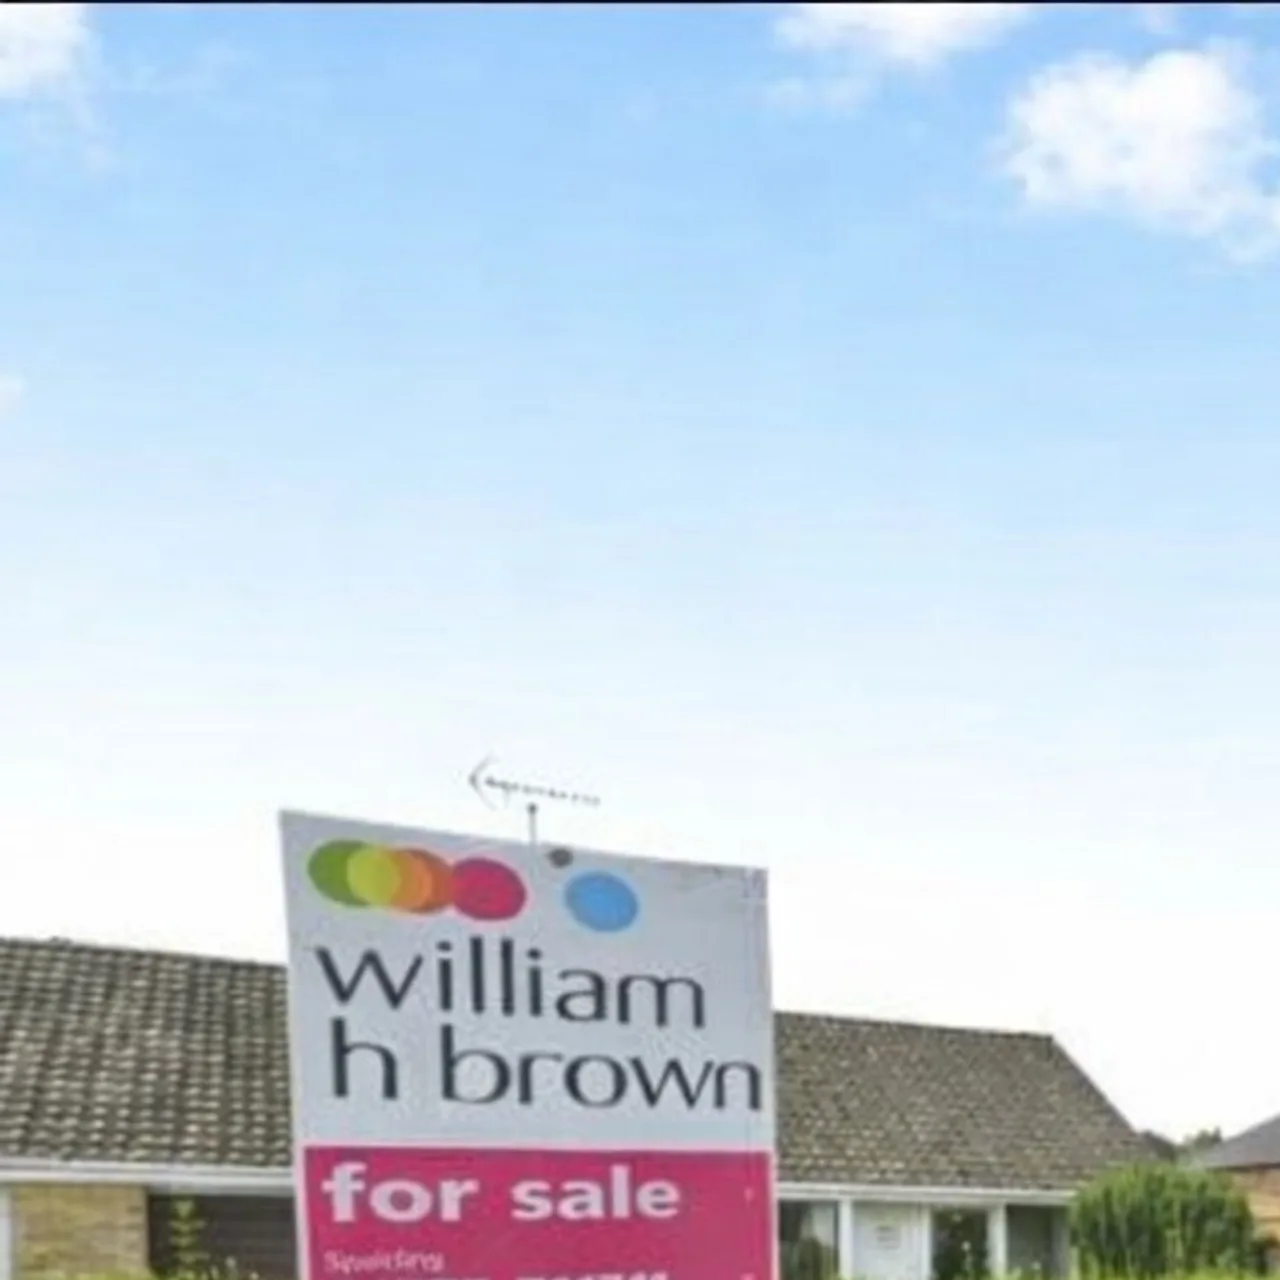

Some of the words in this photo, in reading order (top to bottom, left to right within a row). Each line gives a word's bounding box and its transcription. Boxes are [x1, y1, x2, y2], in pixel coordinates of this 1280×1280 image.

[315, 936, 706, 1029] william
[331, 1017, 398, 1099] h
[440, 1022, 762, 1111] brown
[321, 1162, 479, 1222] for
[510, 1165, 680, 1220] sale
